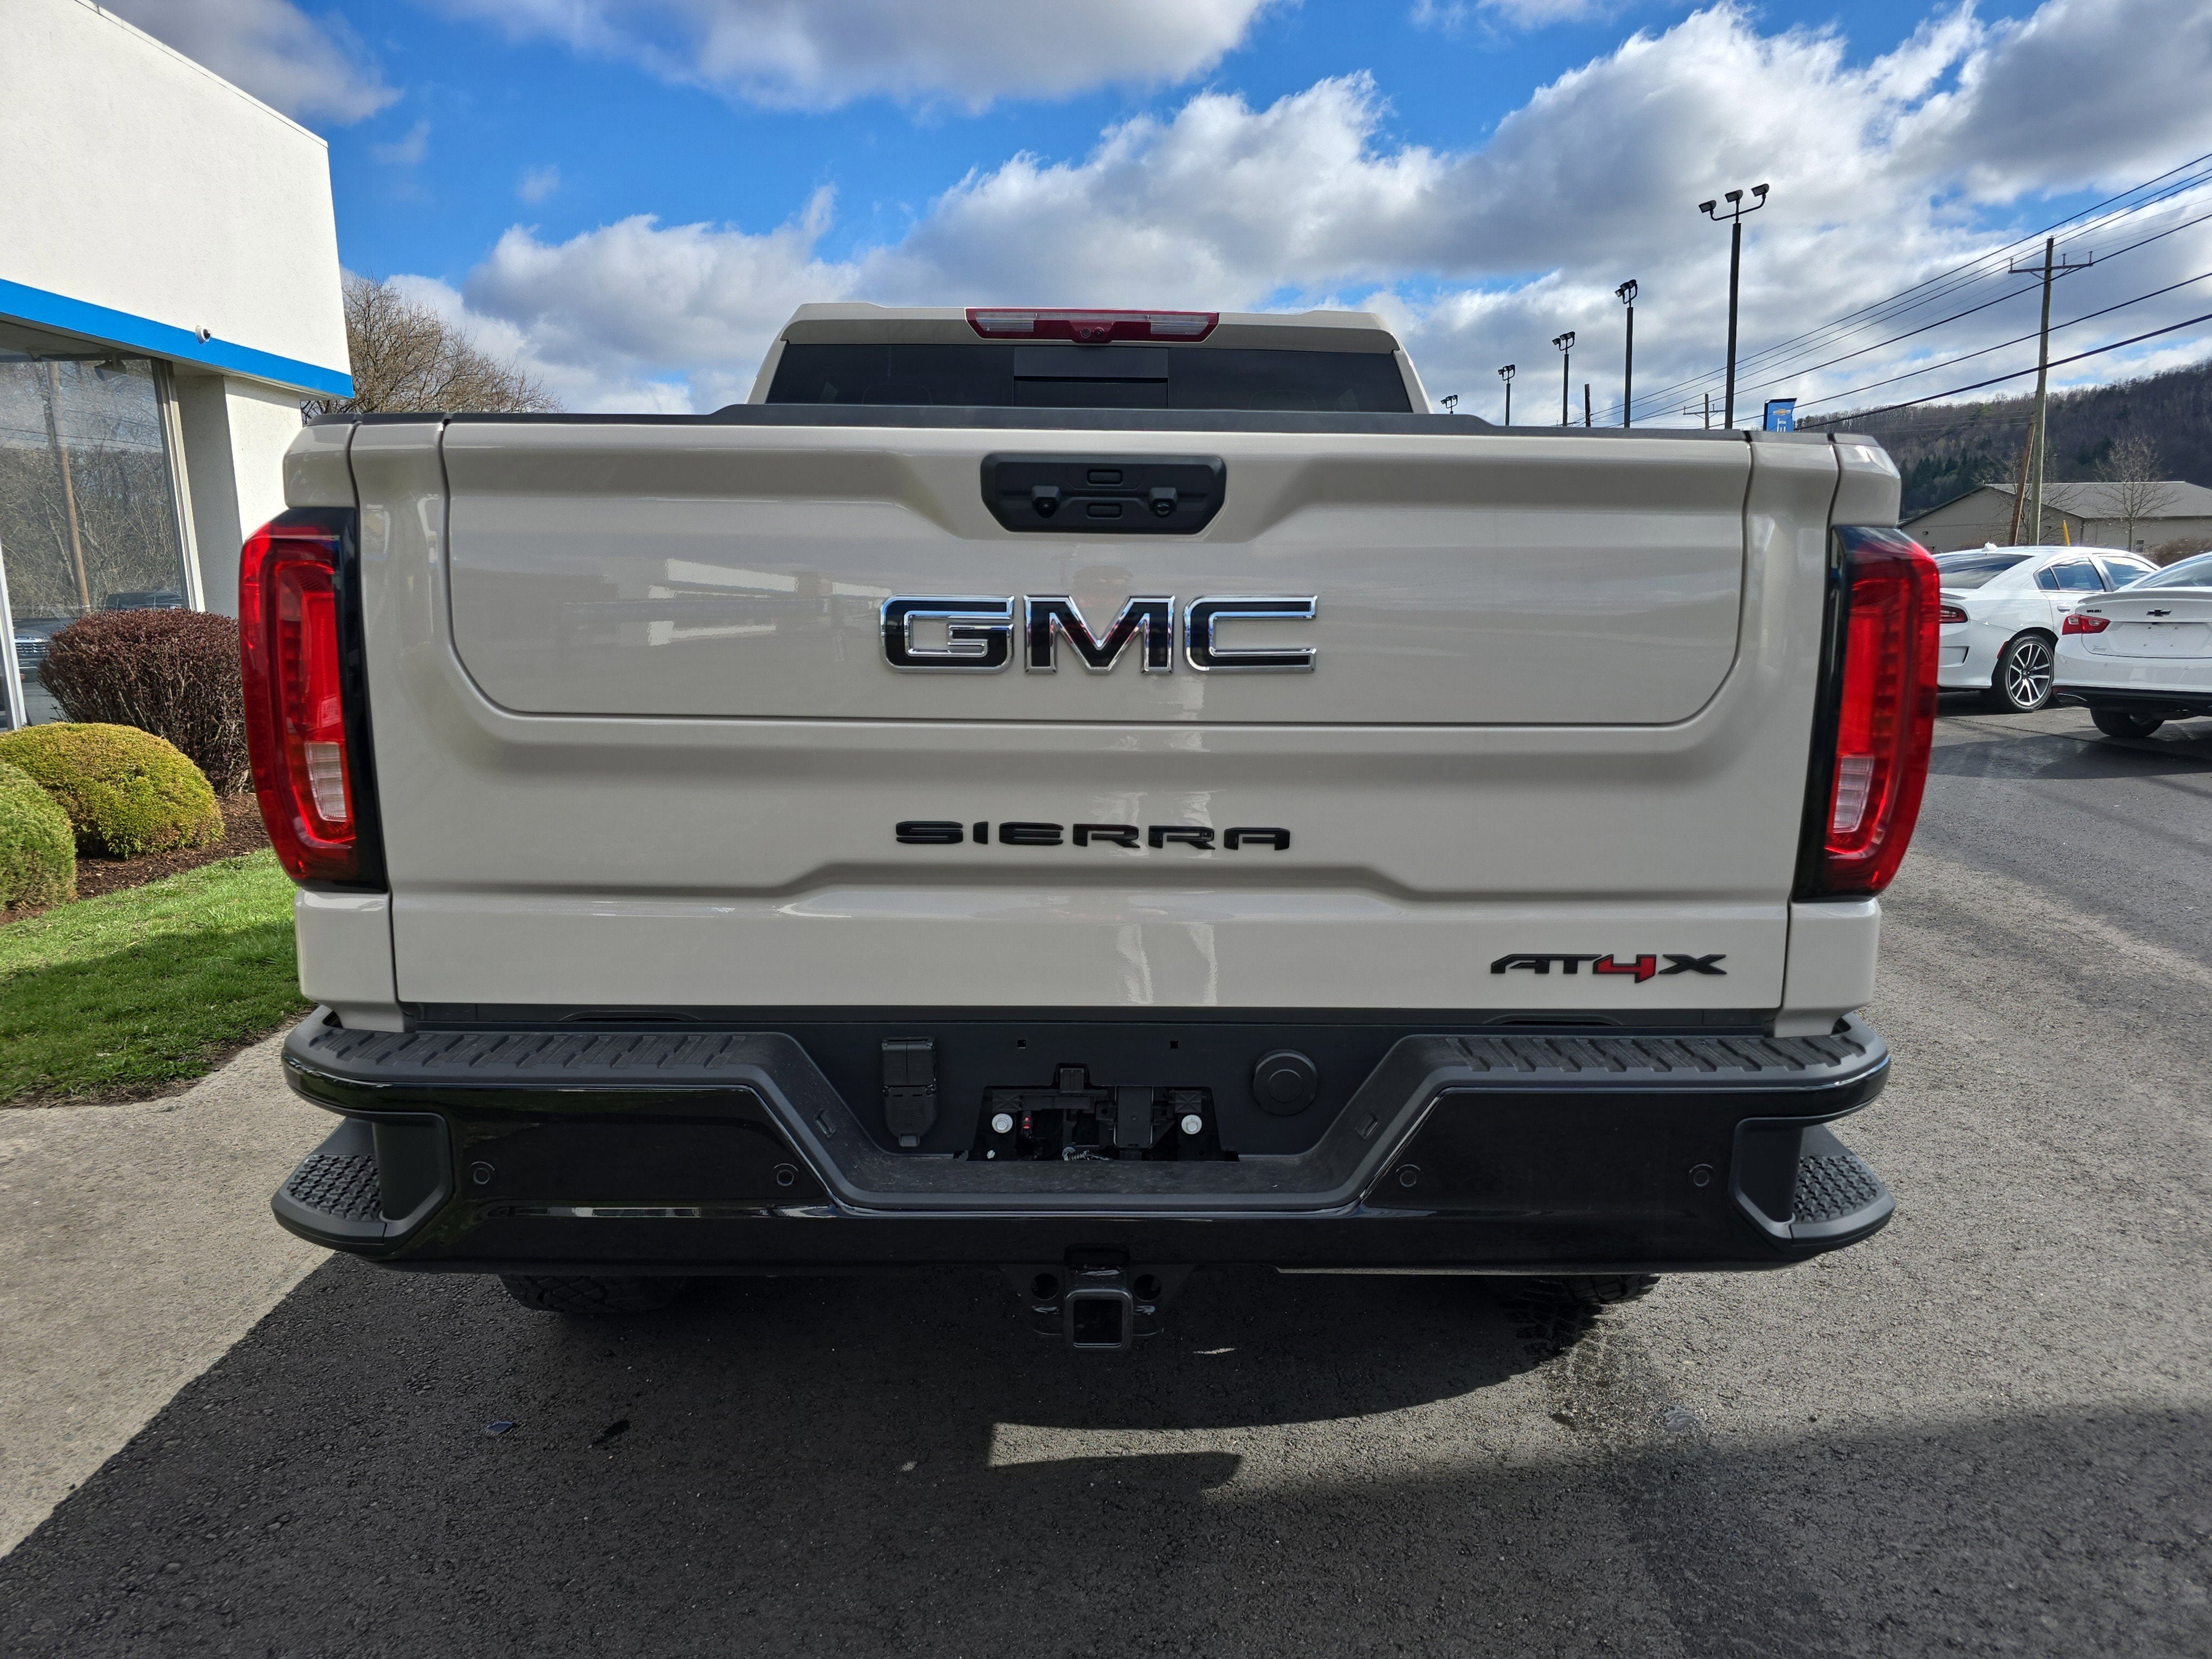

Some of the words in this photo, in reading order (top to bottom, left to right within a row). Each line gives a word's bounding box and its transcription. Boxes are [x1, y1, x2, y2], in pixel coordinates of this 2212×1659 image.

[879, 594, 1317, 674] GMC
[896, 820, 1290, 851] SIERRA
[1490, 954, 1727, 983] AT4X
